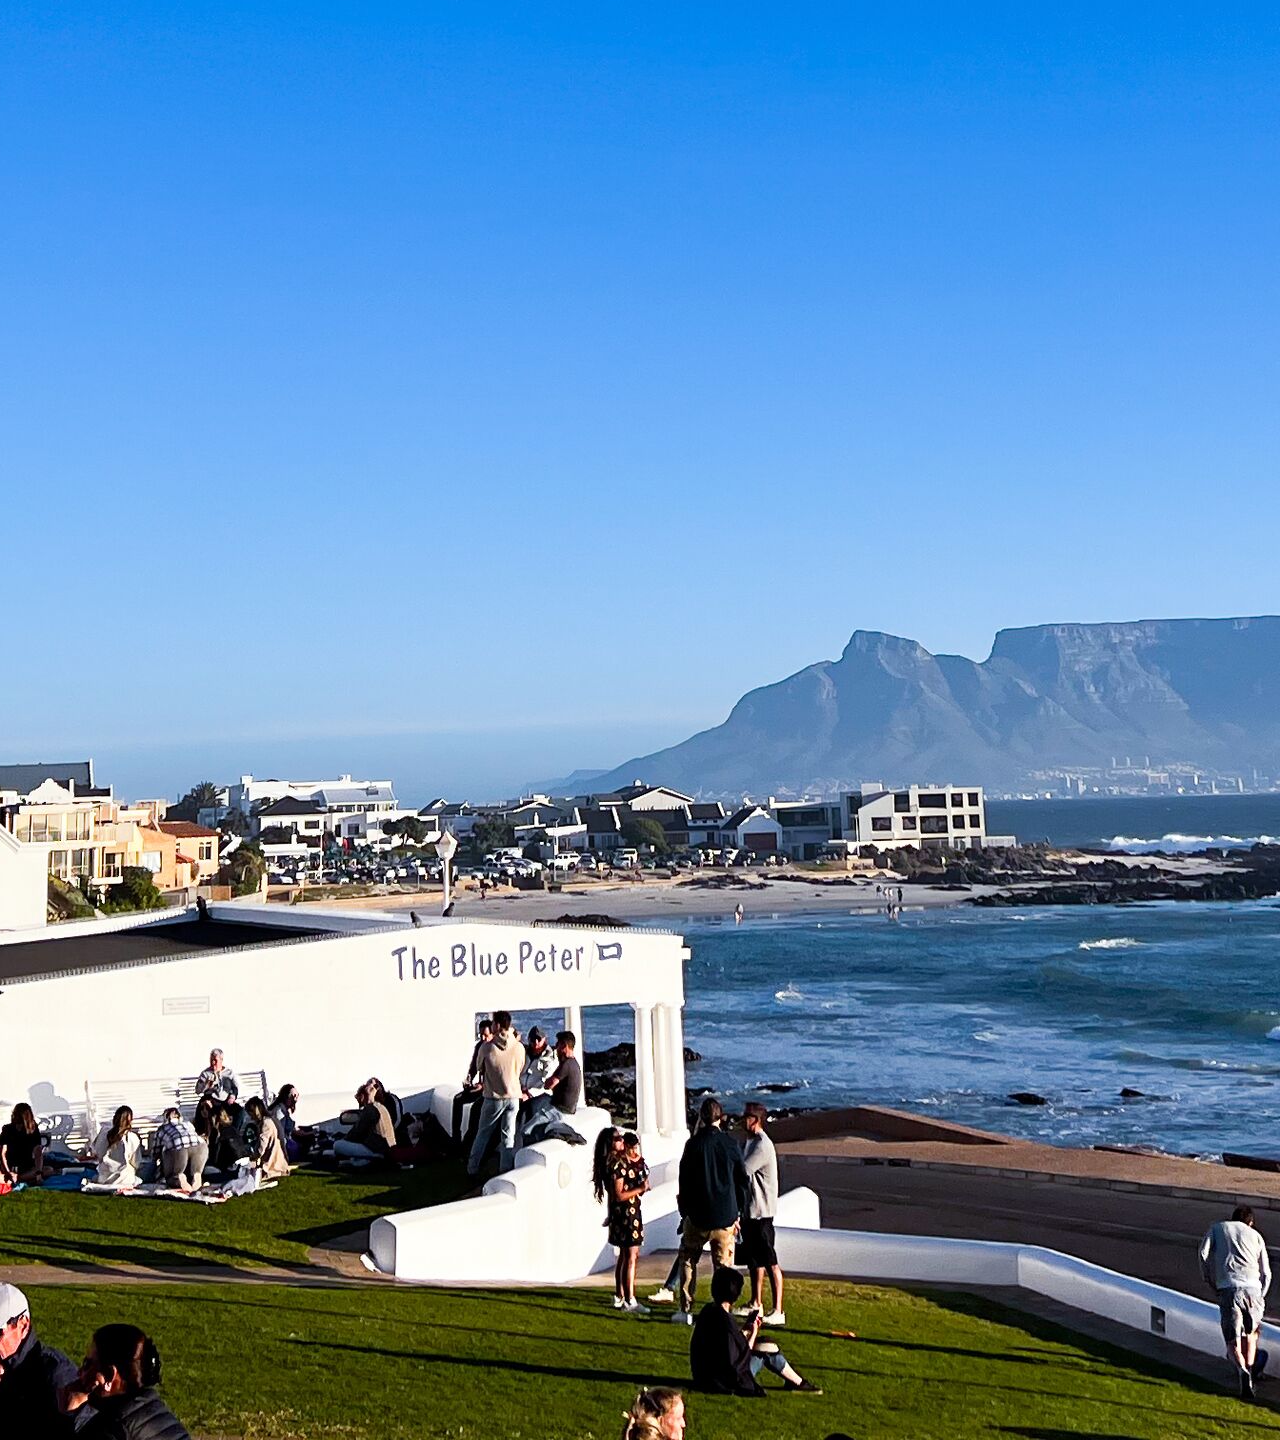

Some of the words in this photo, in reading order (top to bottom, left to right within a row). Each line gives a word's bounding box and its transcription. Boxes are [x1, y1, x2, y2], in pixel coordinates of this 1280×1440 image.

[391, 946, 440, 980] The
[451, 942, 508, 978] Blue
[519, 941, 583, 973] Peter
